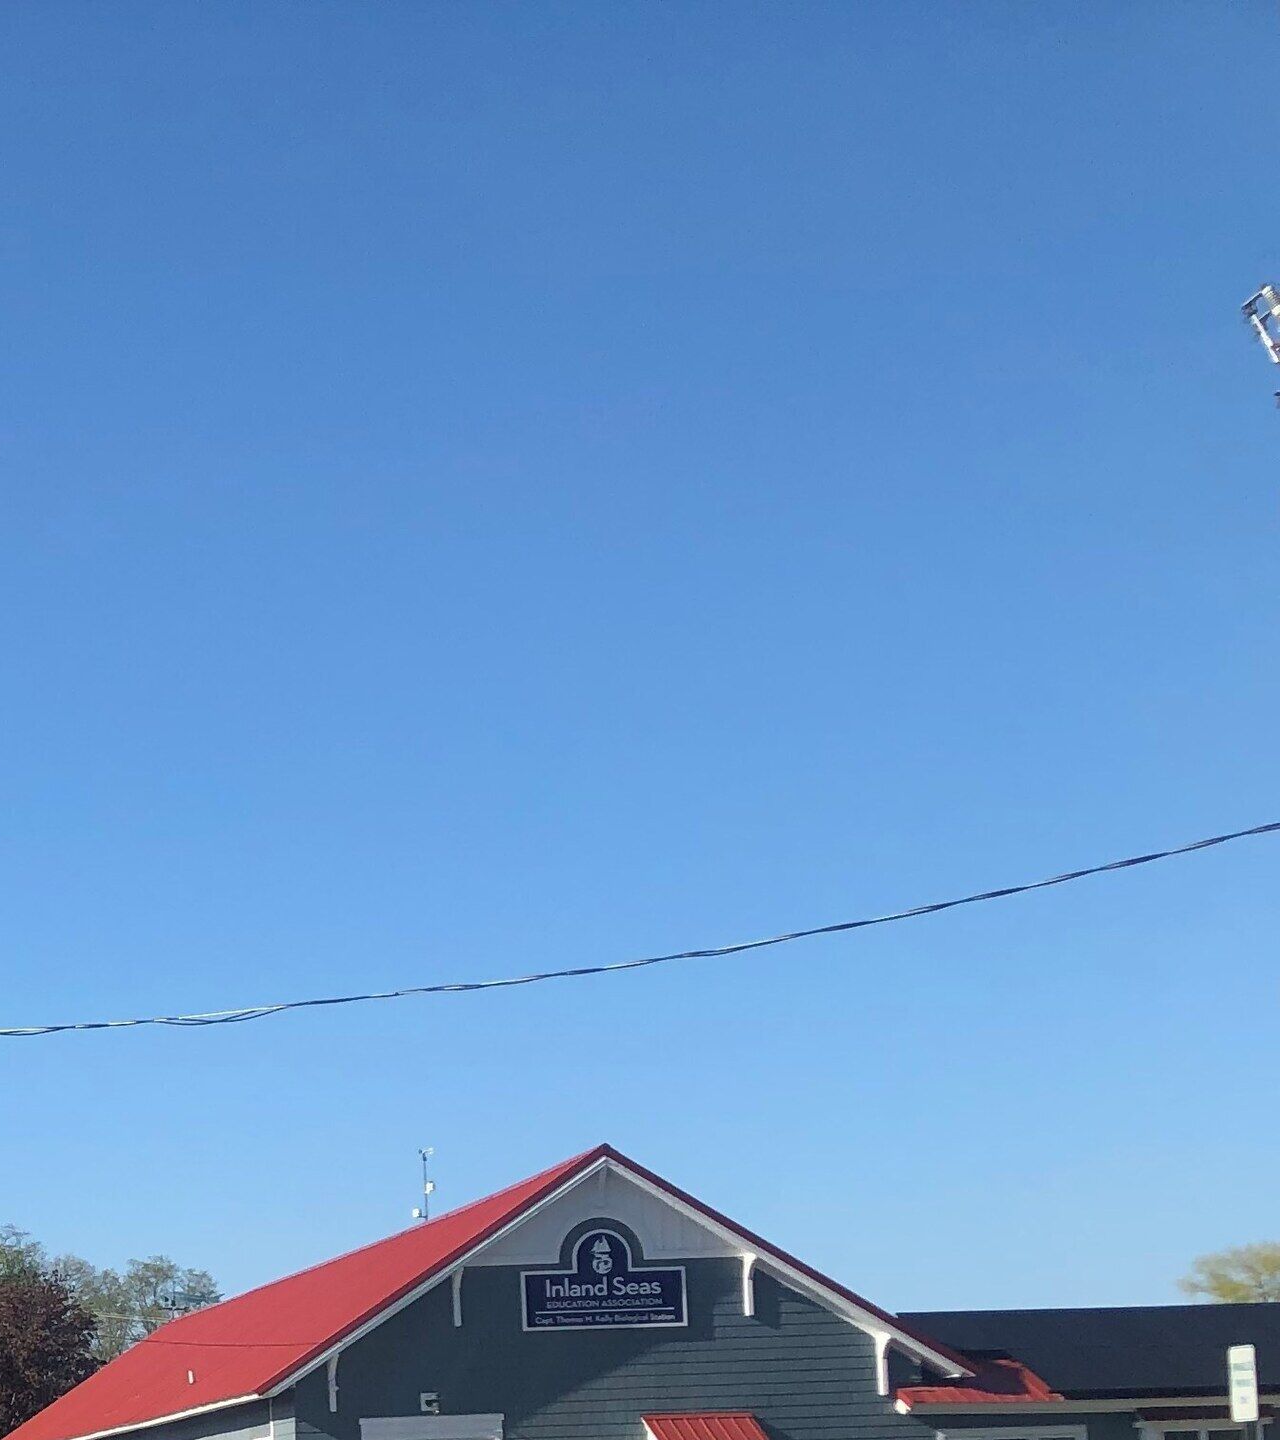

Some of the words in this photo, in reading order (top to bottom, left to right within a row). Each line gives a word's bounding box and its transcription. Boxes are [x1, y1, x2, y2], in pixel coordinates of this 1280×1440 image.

[545, 1277, 608, 1298] Inland
[612, 1276, 662, 1296] Seas
[546, 1300, 600, 1309] EDUCATION
[601, 1298, 663, 1307] ASSOCIATION
